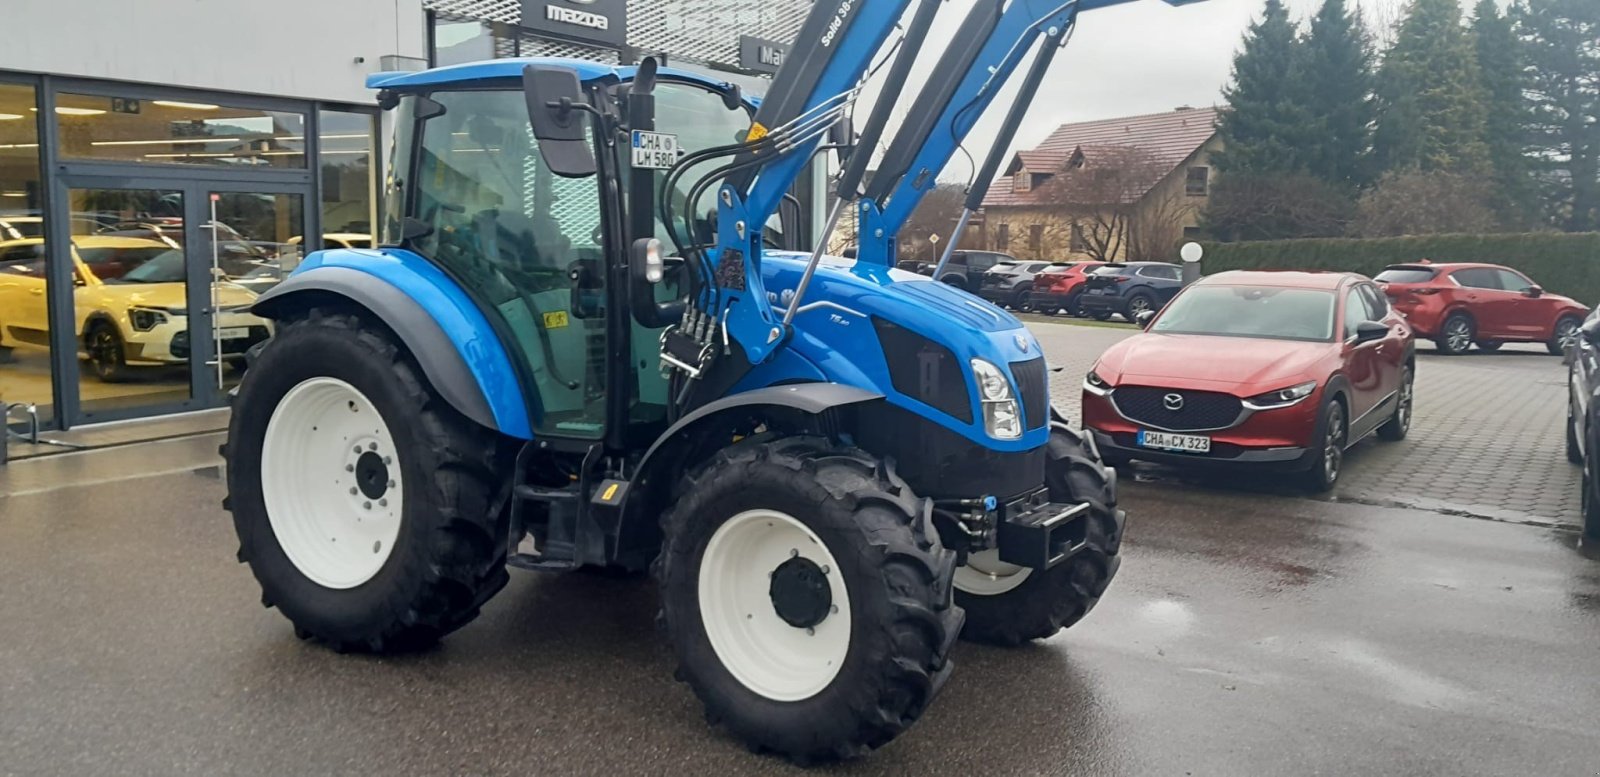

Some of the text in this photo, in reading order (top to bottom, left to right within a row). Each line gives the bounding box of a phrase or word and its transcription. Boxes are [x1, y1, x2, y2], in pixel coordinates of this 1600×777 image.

[821, 15, 842, 47] Solid
[640, 134, 661, 150] CHA
[1145, 432, 1209, 450] CHA CX 323
